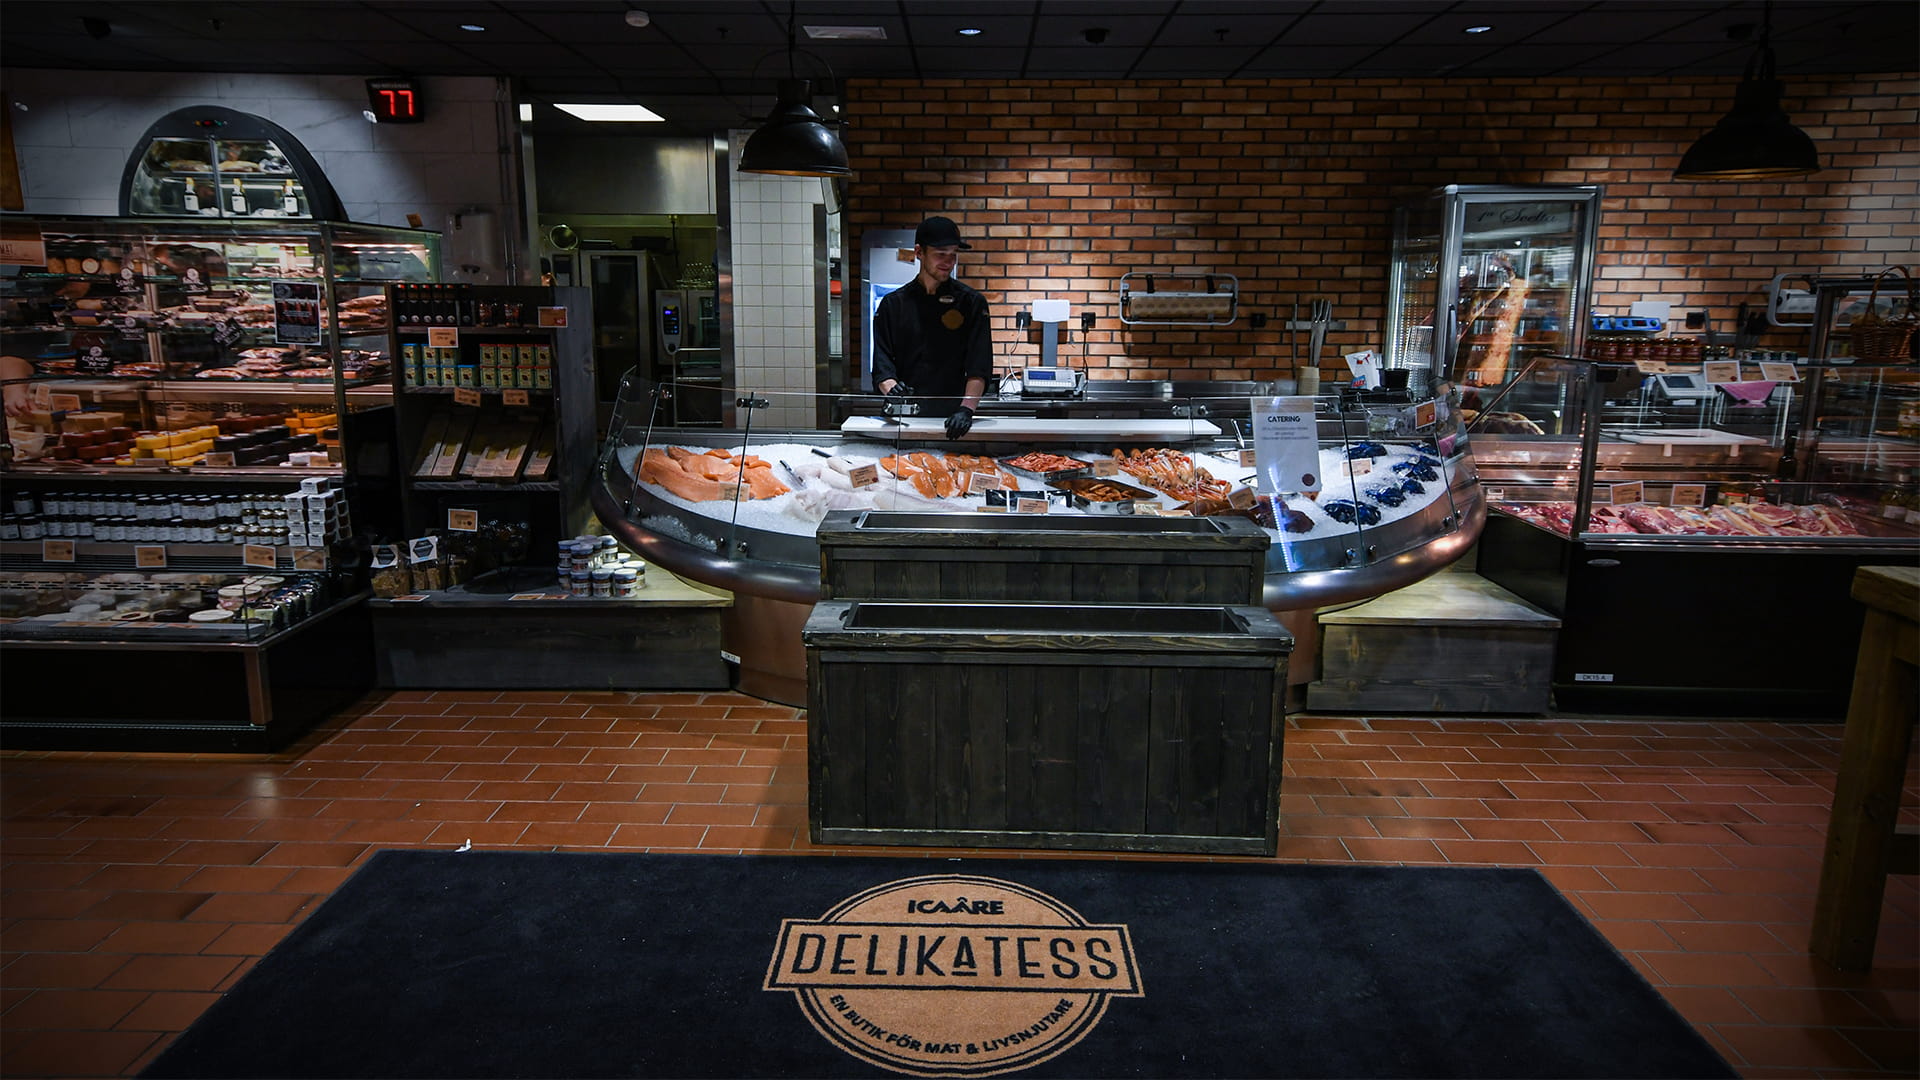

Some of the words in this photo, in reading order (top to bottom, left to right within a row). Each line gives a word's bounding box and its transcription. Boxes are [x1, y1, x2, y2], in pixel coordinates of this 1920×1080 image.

[378, 90, 415, 117] 77
[1268, 415, 1301, 423] CATERING
[791, 932, 1118, 980] DELIKATESS
[829, 994, 850, 1012] EN
[843, 1009, 890, 1040] BUTIK
[885, 1033, 921, 1052] FÖR
[924, 1043, 962, 1055] MAT
[966, 1043, 980, 1055] &
[983, 998, 1075, 1051] LIVSNJUTARE
